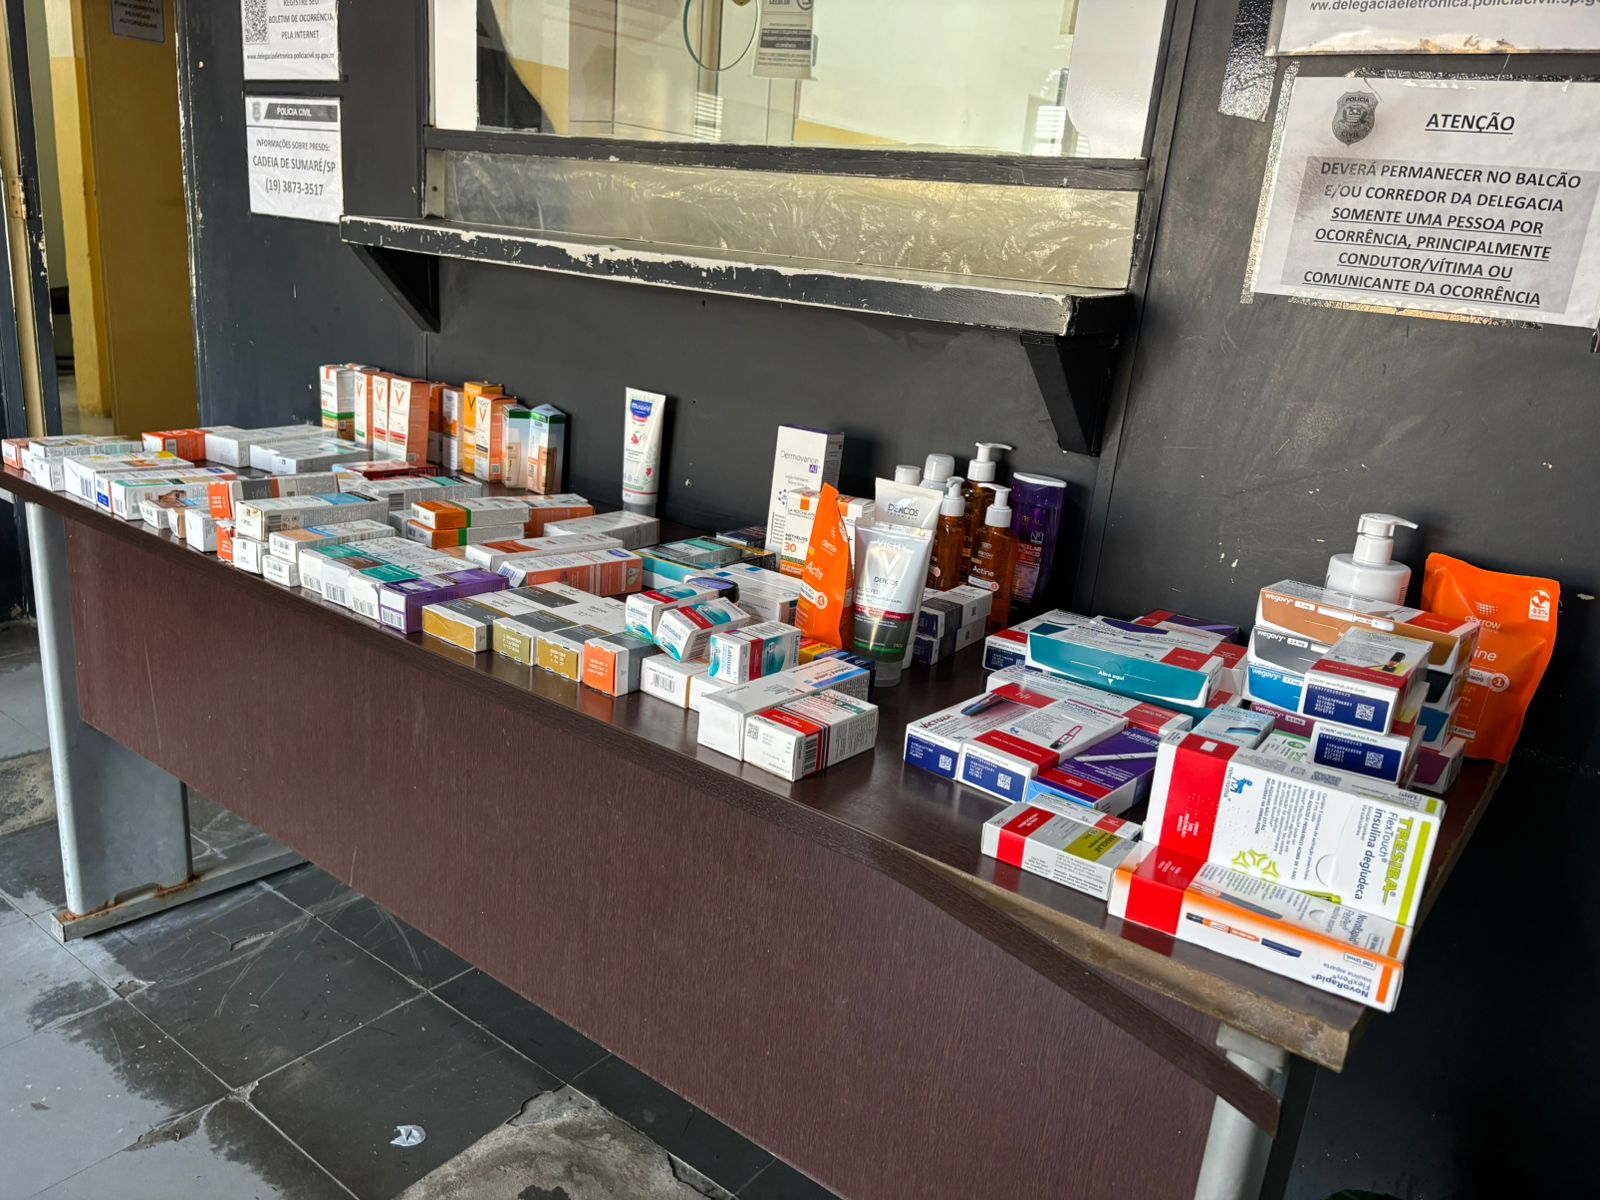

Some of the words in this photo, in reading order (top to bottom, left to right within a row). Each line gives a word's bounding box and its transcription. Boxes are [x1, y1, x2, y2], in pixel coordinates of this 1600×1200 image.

[269, 15, 290, 24] BOLETIM
[291, 15, 298, 23] DE
[299, 13, 334, 23] OCORRÊNCIA
[281, 31, 294, 39] PELA
[294, 30, 319, 39] INTERNET
[276, 106, 297, 116] POLÍCIA
[298, 107, 312, 117] CIVIL
[1426, 112, 1515, 133] ATENÇÃO
[256, 138, 290, 149] INFORMAÇÕES
[291, 141, 308, 150] SOBRE
[309, 142, 331, 151] PRESOS:
[252, 155, 279, 168] CADEIA
[280, 157, 290, 169] DE
[291, 158, 336, 173] SUMARÉ/SP
[1321, 161, 1376, 177] DEVERÁ
[1380, 165, 1482, 184] PERMANECER
[1487, 171, 1511, 185] NO
[1515, 170, 1581, 189] BALCÃO
[265, 178, 281, 195] (19)
[282, 180, 324, 196] 3873-3517
[1324, 184, 1361, 199] E/OU
[1365, 187, 1446, 204] CORREDOR
[1450, 192, 1472, 205] DA
[1476, 194, 1564, 212] DELEGACIA
[1331, 206, 1402, 224] SOMENTE
[1406, 212, 1443, 226] UMA
[1446, 215, 1506, 231] PESSOA
[1510, 220, 1544, 235] POR
[1314, 227, 1412, 250] OCORRÊNCIA,
[1416, 236, 1552, 259] PRINCIPALMENTE
[1338, 252, 1484, 276] CONDUTOR/VÍTIMA
[1488, 265, 1513, 279] OU
[1303, 271, 1411, 292] COMUNICANTE
[1414, 282, 1436, 294] DA
[1440, 283, 1541, 305] OCORRÊNCIA
[780, 450, 819, 464] Dermovance
[888, 503, 919, 517] DERCOS
[784, 542, 797, 553] 30
[972, 565, 994, 577] Actine
[1464, 615, 1501, 630] darrow
[1098, 670, 1112, 678] Abra
[1112, 673, 1125, 681] aqui
[1367, 808, 1386, 848] insulina
[1354, 851, 1377, 900] degludeca
[1347, 971, 1373, 983] insulina
